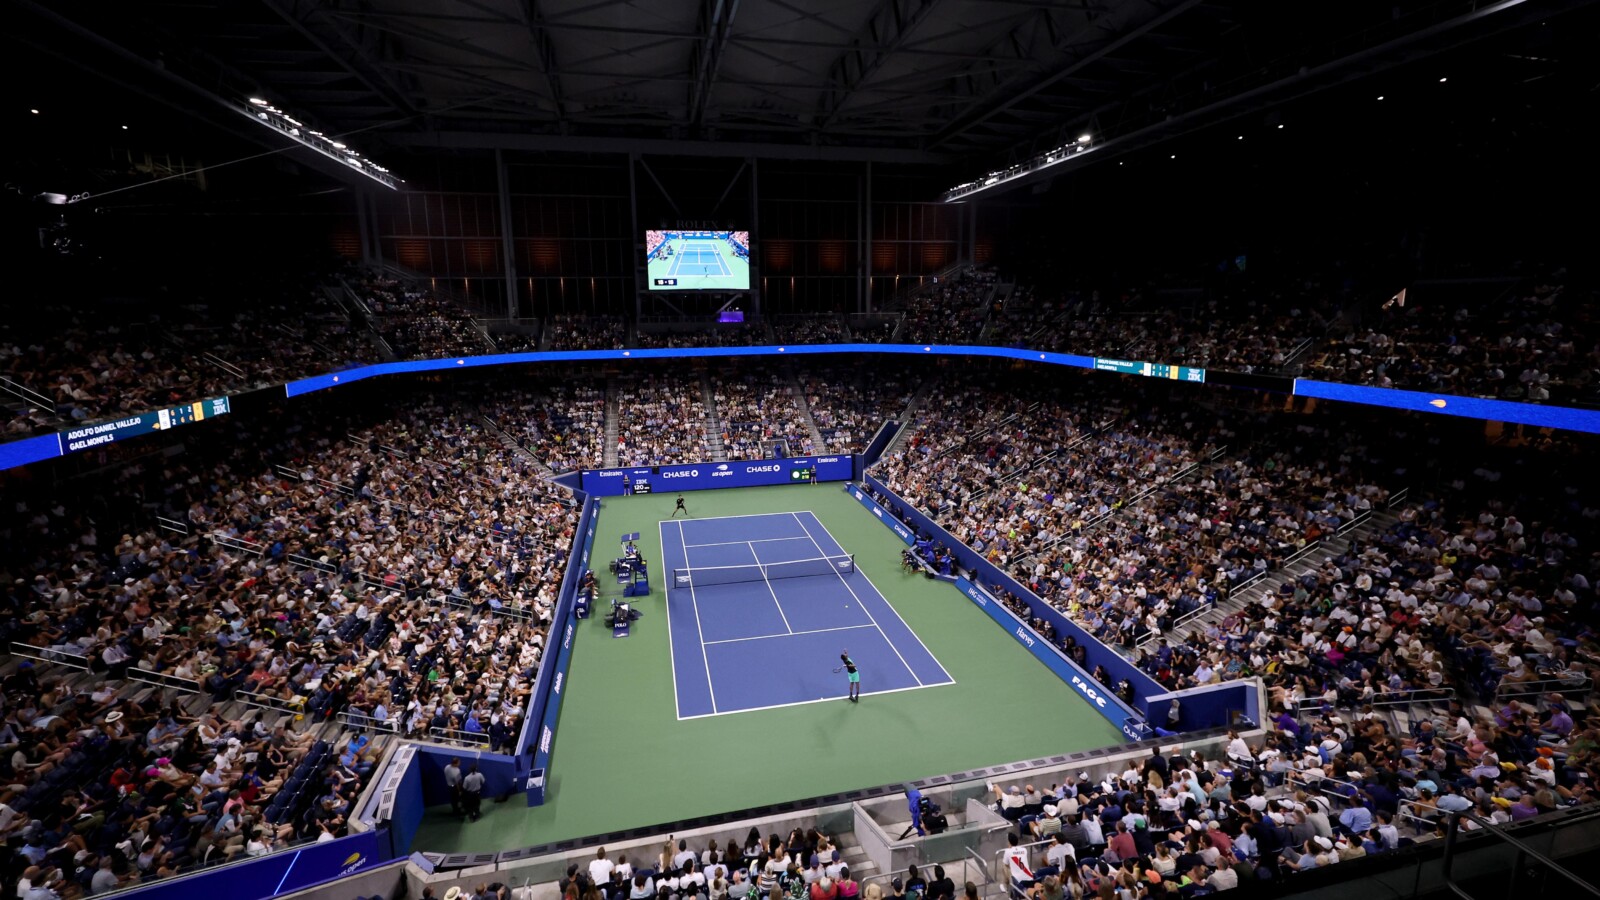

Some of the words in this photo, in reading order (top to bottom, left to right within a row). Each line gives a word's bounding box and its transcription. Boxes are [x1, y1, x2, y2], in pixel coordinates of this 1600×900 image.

[677, 220, 718, 229] ROLEX
[213, 404, 227, 415] IBM
[67, 428, 94, 440] ADOLFO
[95, 422, 117, 434] DANIEL
[116, 417, 141, 430] VALLEJO
[69, 440, 87, 451] GAEL
[87, 434, 114, 447] MONFILS
[663, 470, 690, 479] CHASE
[719, 470, 733, 478] open
[747, 465, 773, 473] CHASE
[1016, 626, 1035, 648] Harvey
[1071, 675, 1107, 708] FAGE
[1018, 857, 1025, 870] 6
